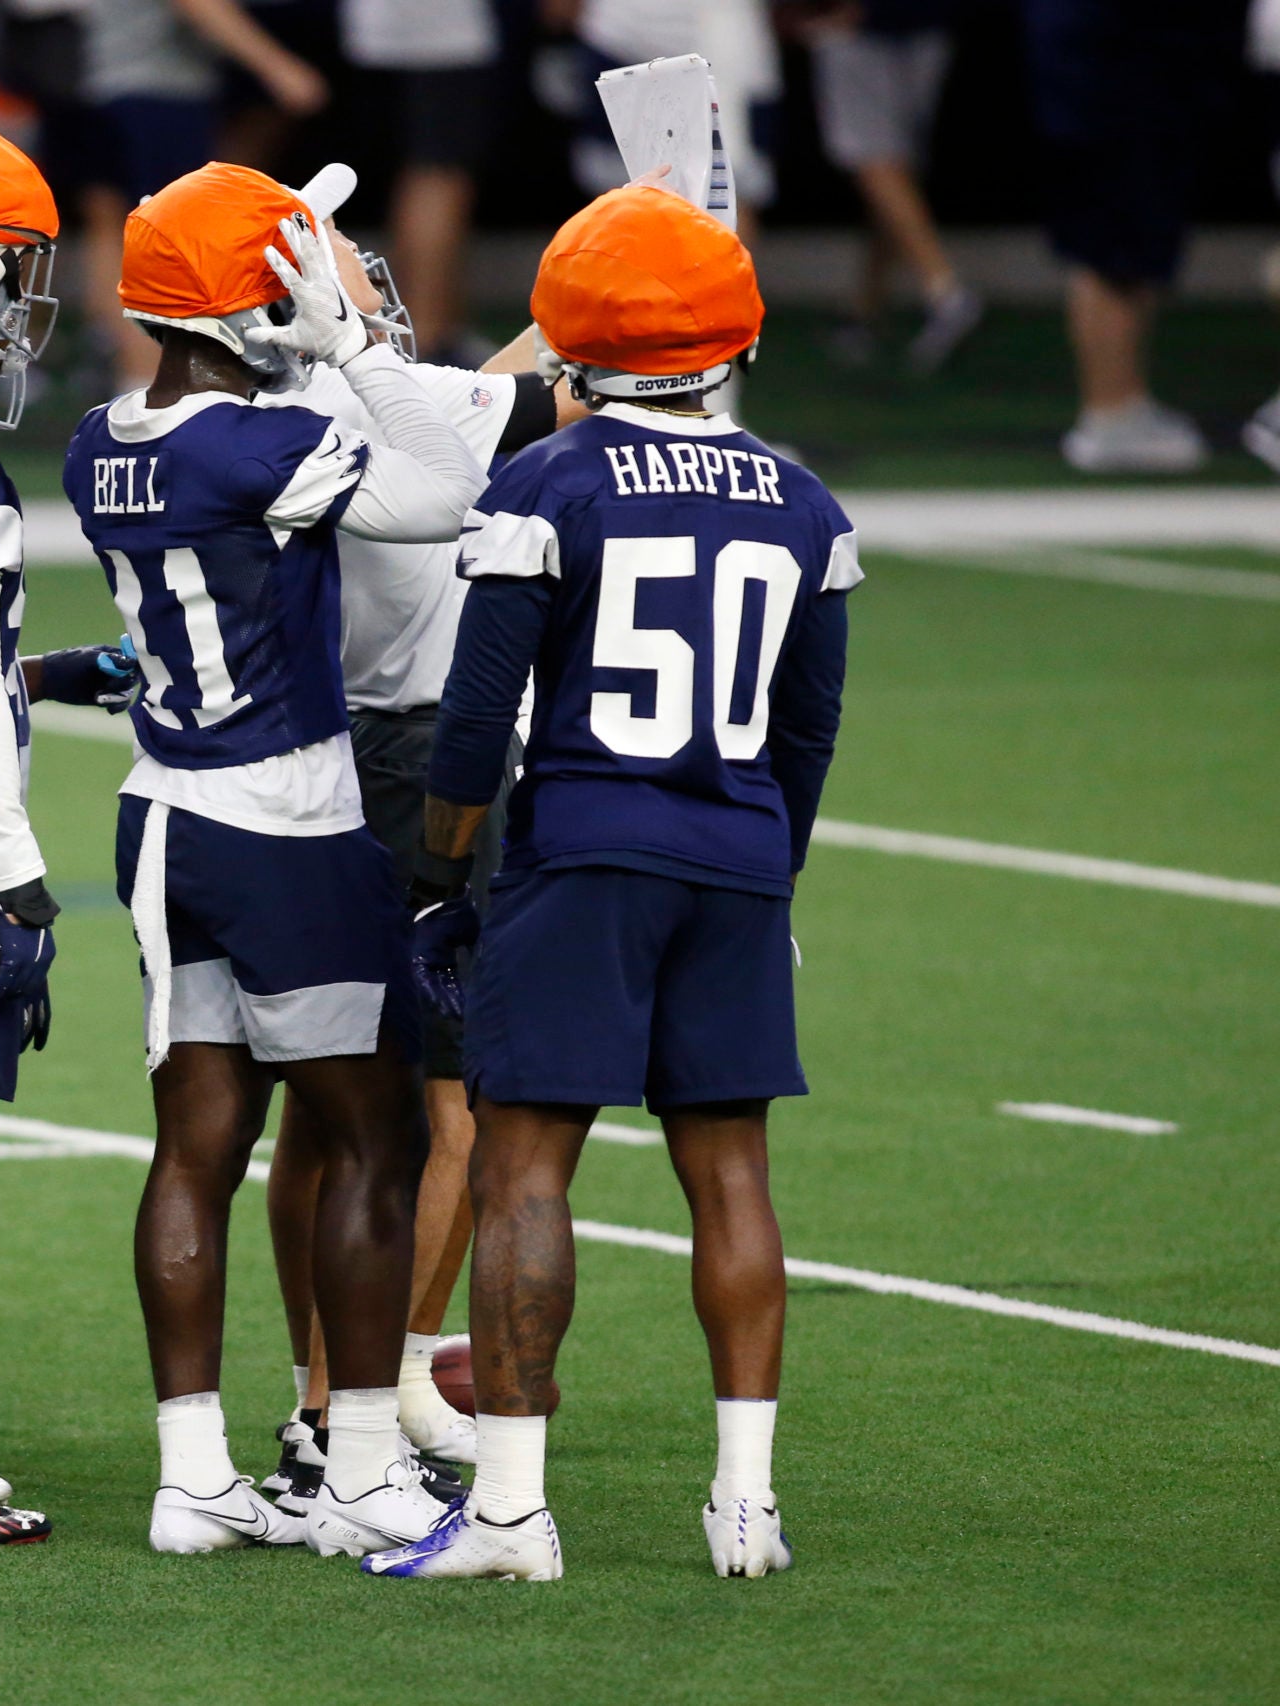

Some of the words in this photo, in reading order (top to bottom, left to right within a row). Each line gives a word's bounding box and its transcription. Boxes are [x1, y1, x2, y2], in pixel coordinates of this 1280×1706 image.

[635, 372, 705, 391] COWBOYS
[93, 457, 166, 514] BELL
[604, 442, 784, 504] HARPER
[104, 547, 253, 732] 11
[590, 535, 803, 760] 50
